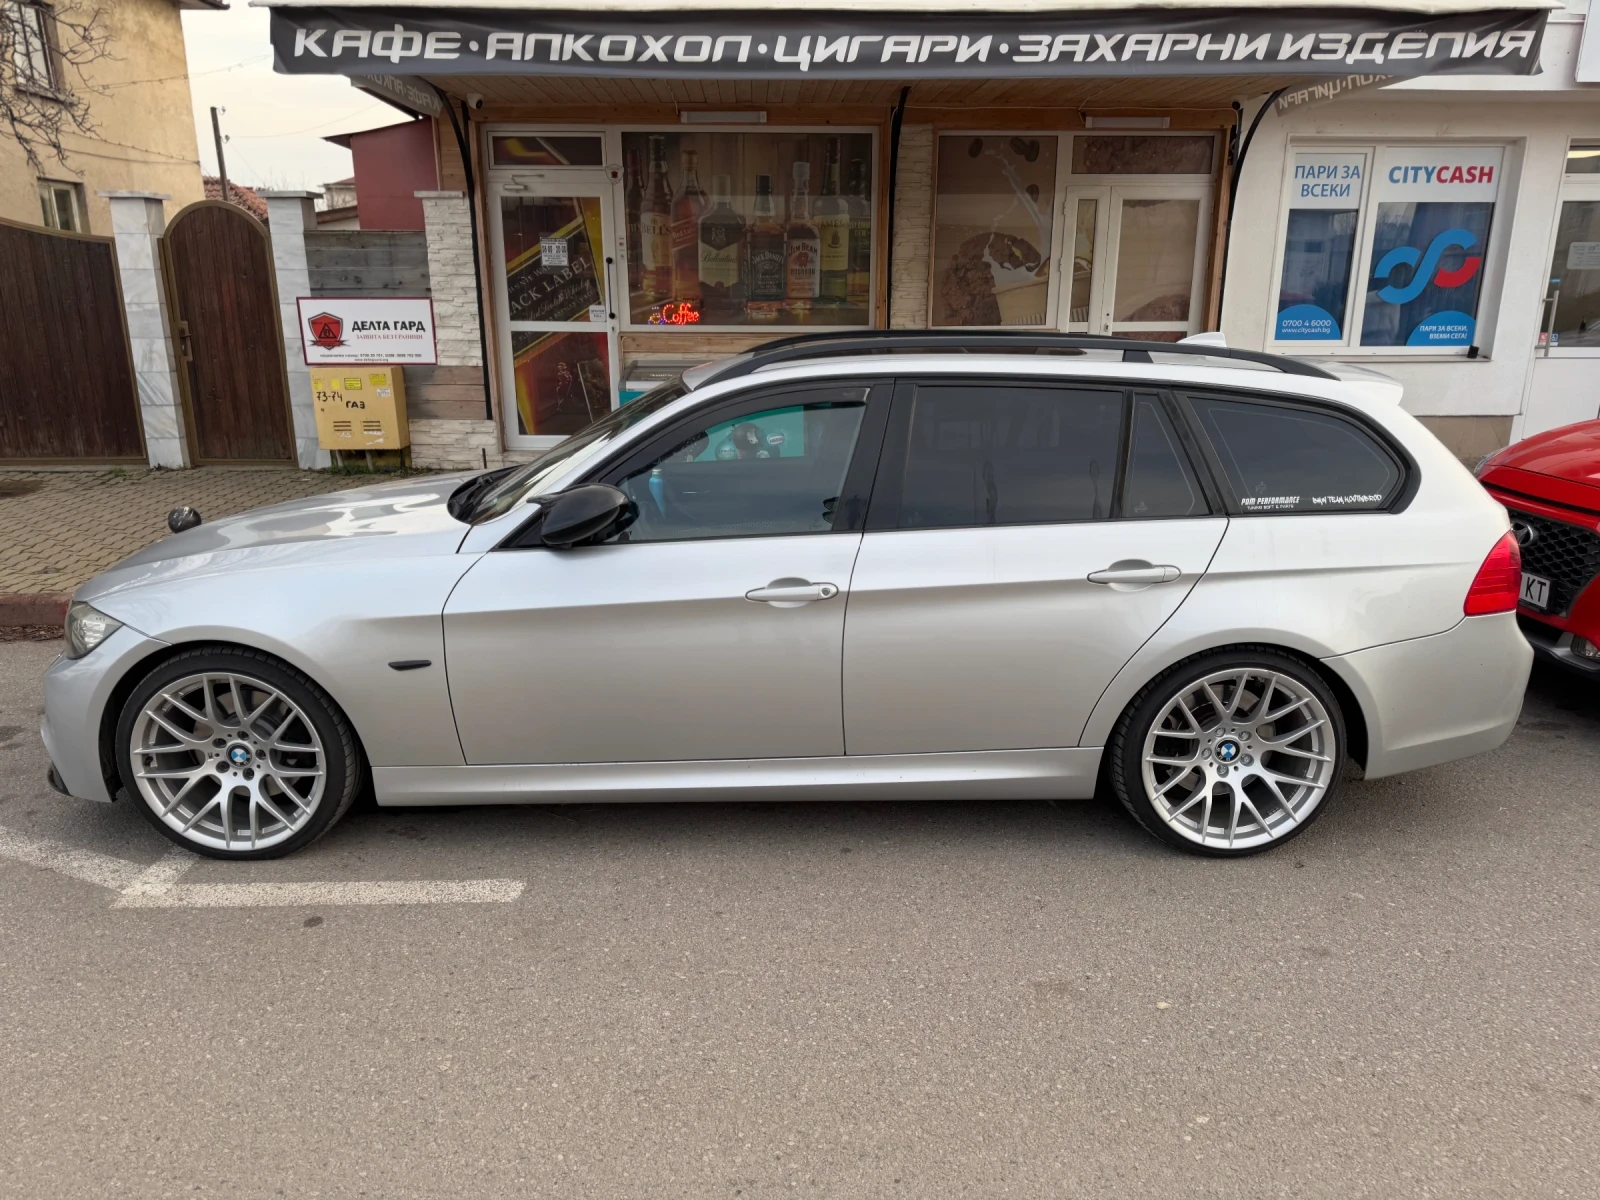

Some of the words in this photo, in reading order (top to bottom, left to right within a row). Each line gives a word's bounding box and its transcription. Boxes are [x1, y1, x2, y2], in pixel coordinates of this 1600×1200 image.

[294, 24, 461, 64] КАФЕ
[486, 32, 752, 63] АЛКОХОЛ
[773, 34, 993, 72] ЦИГАРИ
[1012, 33, 1272, 63] ЗАХАРНИ
[1276, 30, 1537, 65] ИЗДЕЛИЯ
[1294, 165, 1339, 179] ПАРИ
[1341, 165, 1361, 179] ЗА
[1388, 165, 1495, 184] CITYCASH
[1300, 183, 1351, 198] ВСЕКИ
[788, 244, 801, 257] JIM
[801, 242, 818, 257] BEAM
[543, 256, 591, 293] LABEL
[663, 303, 700, 325] Coffee
[351, 320, 391, 333] ДЕЛТА
[393, 320, 426, 333] ГАРД
[1282, 319, 1302, 327] 0700
[1304, 319, 1310, 327] 4
[1311, 319, 1332, 327] 6000
[1446, 325, 1468, 333] ВСЕКИ,
[316, 391, 343, 402] 73-74
[345, 400, 366, 410] ГАЗ
[1256, 495, 1301, 505] PERFORMANCE
[1525, 576, 1547, 602] KT
